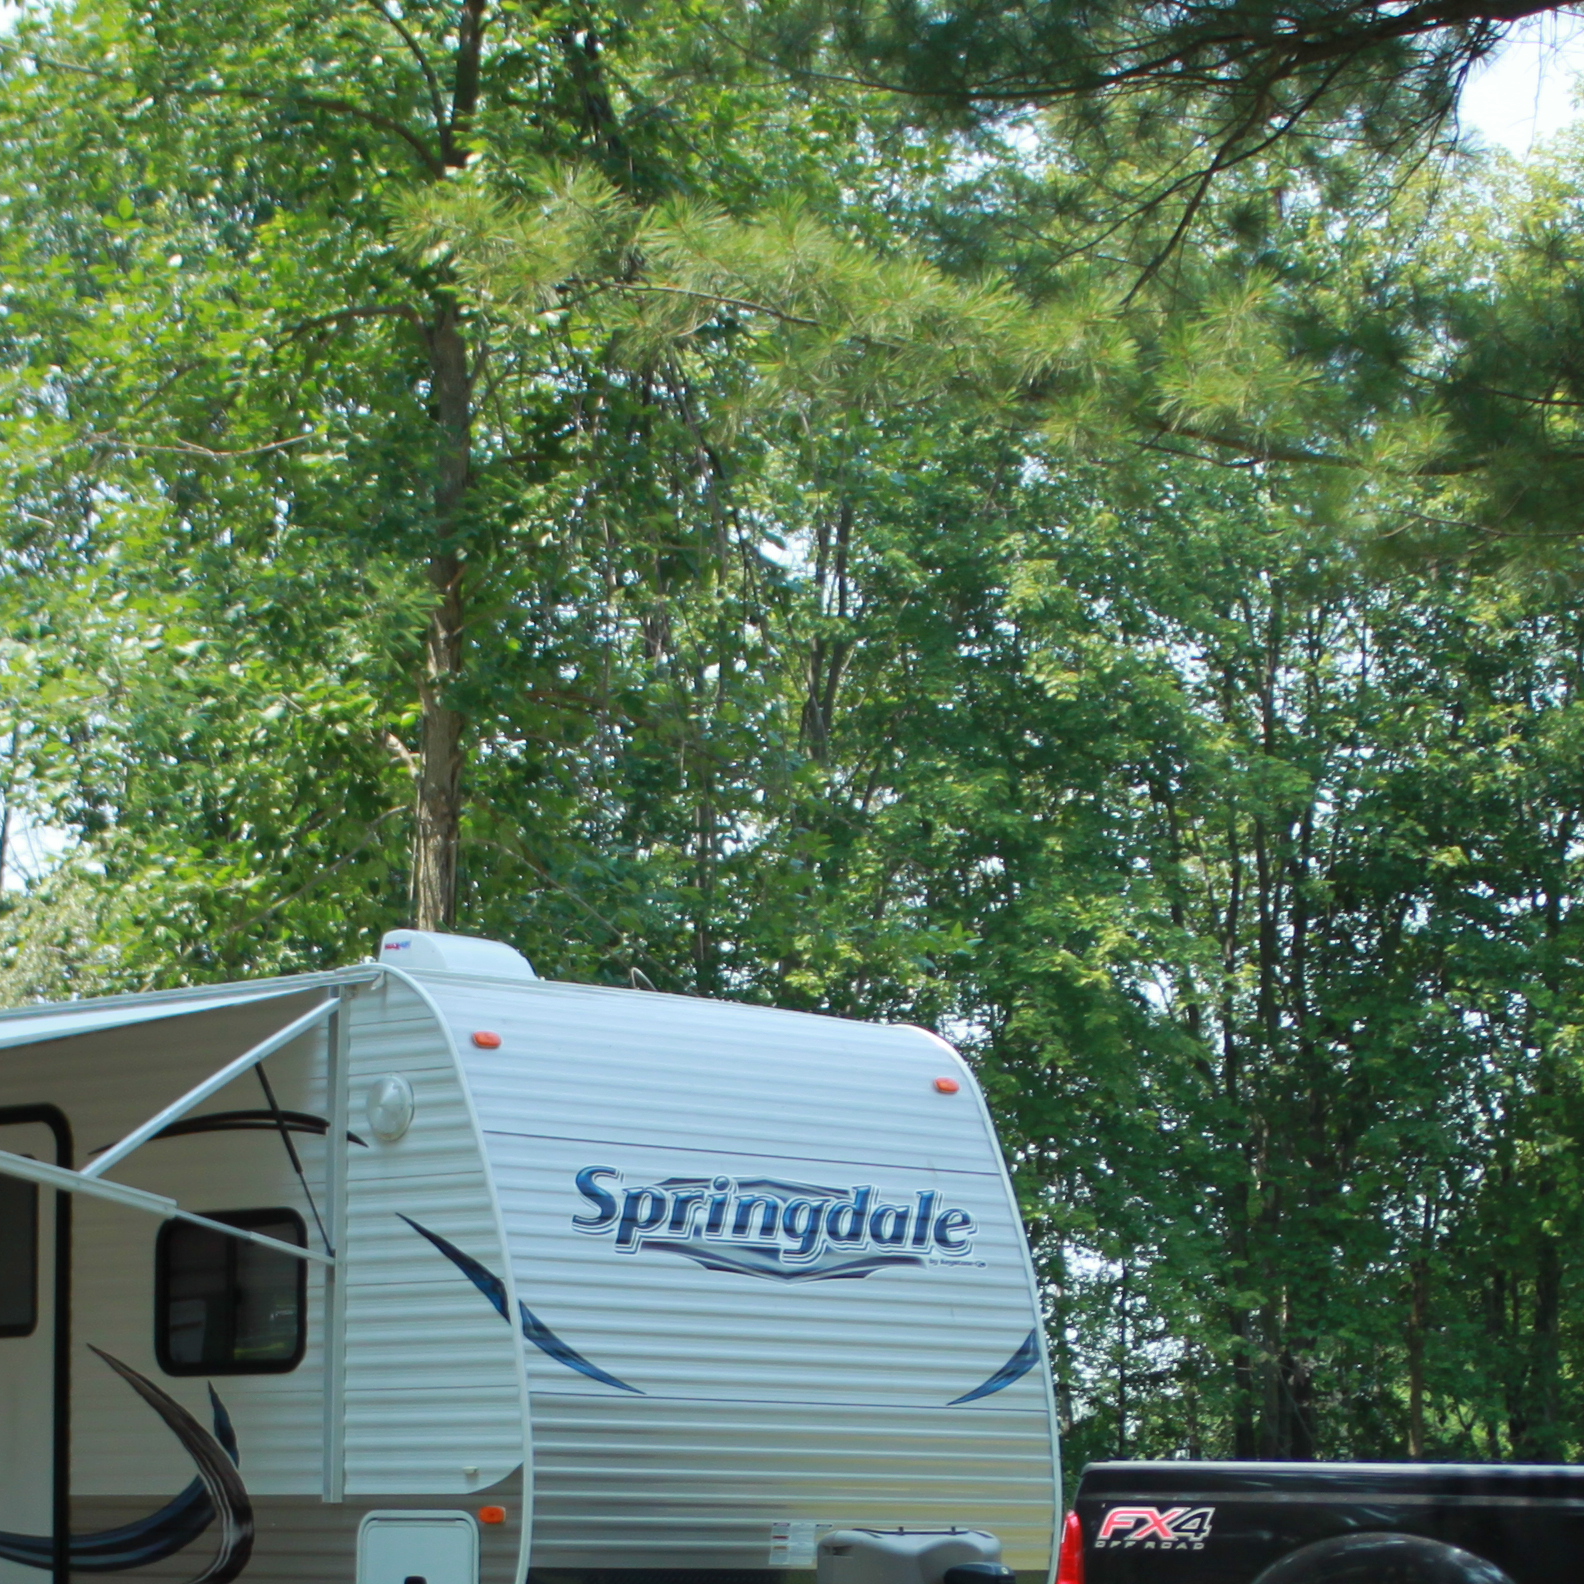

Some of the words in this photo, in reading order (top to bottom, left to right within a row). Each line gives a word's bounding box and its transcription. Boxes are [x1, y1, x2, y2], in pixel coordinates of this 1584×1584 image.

[571, 1164, 978, 1264] Springdale
[1097, 1506, 1215, 1542] FX4
[1094, 1540, 1137, 1549] OFF
[1144, 1541, 1205, 1550] ROAD
